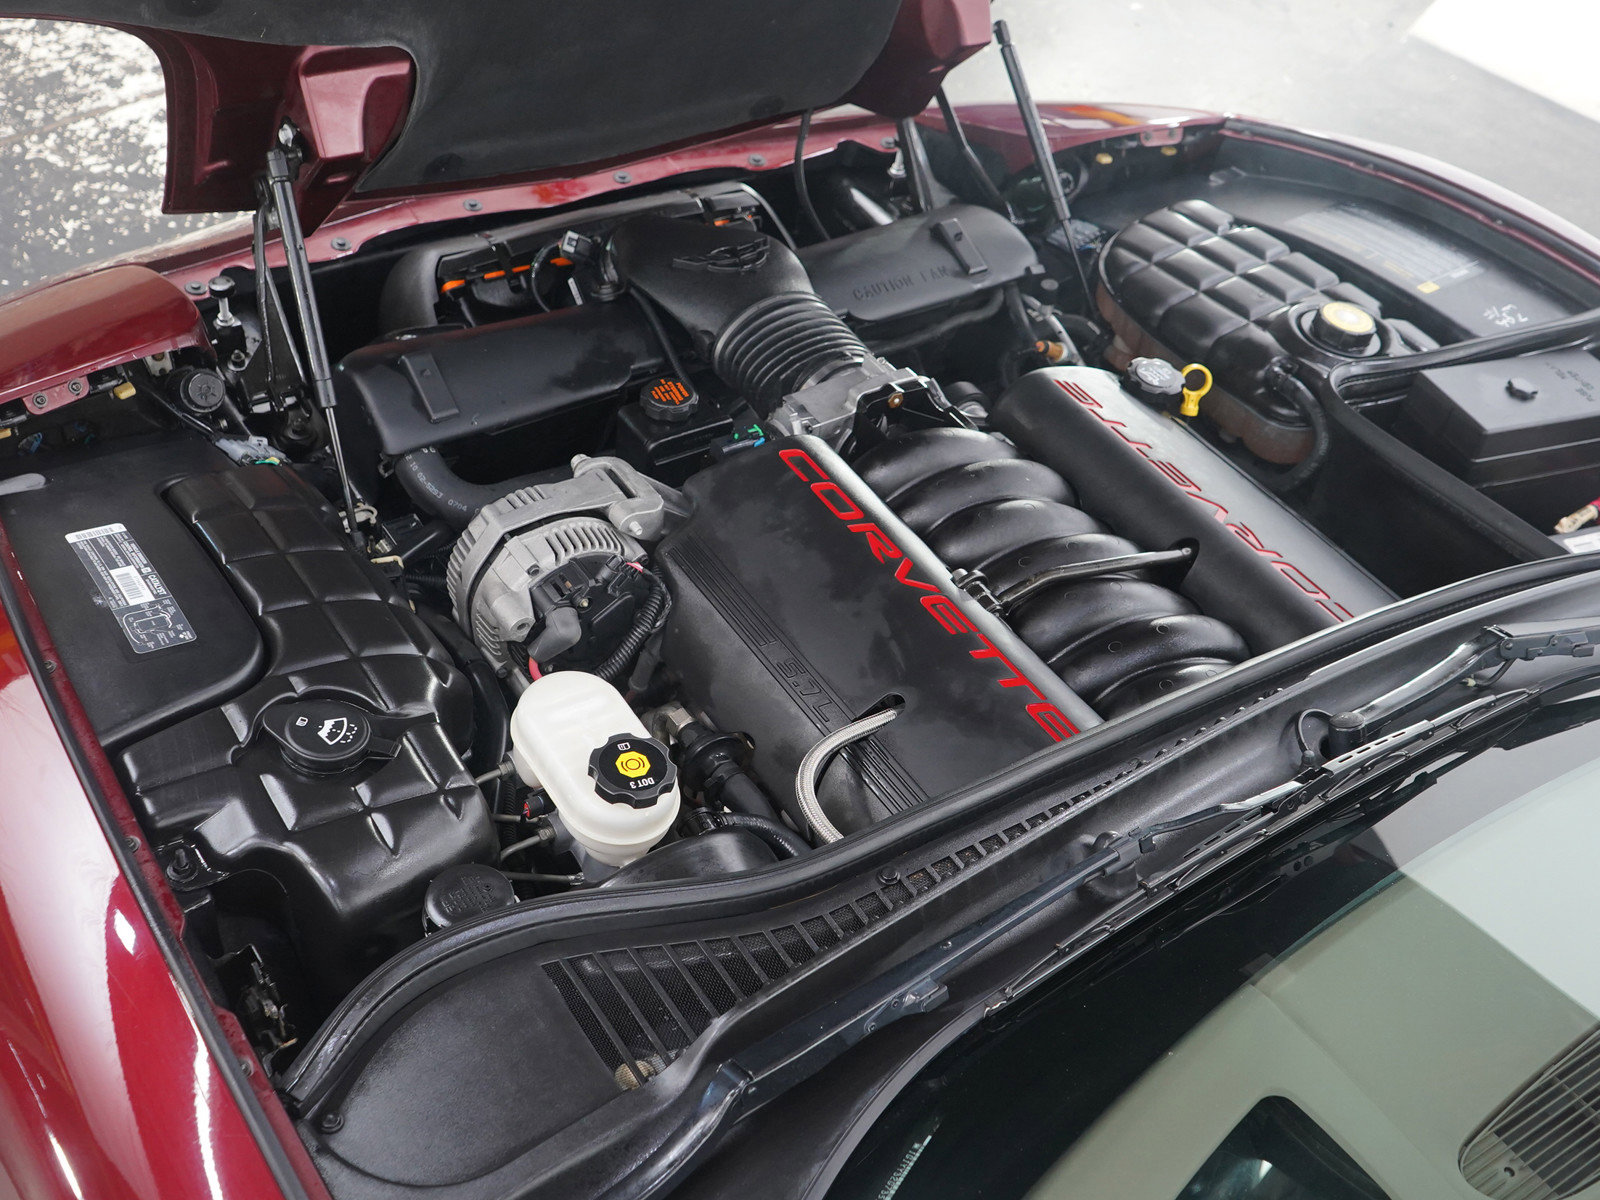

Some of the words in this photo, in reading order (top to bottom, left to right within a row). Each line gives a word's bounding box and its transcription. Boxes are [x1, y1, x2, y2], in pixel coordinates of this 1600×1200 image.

[852, 275, 913, 301] CAUTION
[778, 448, 1082, 743] CORVETTE
[776, 658, 833, 722] 5.7L
[638, 777, 654, 787] DOT
